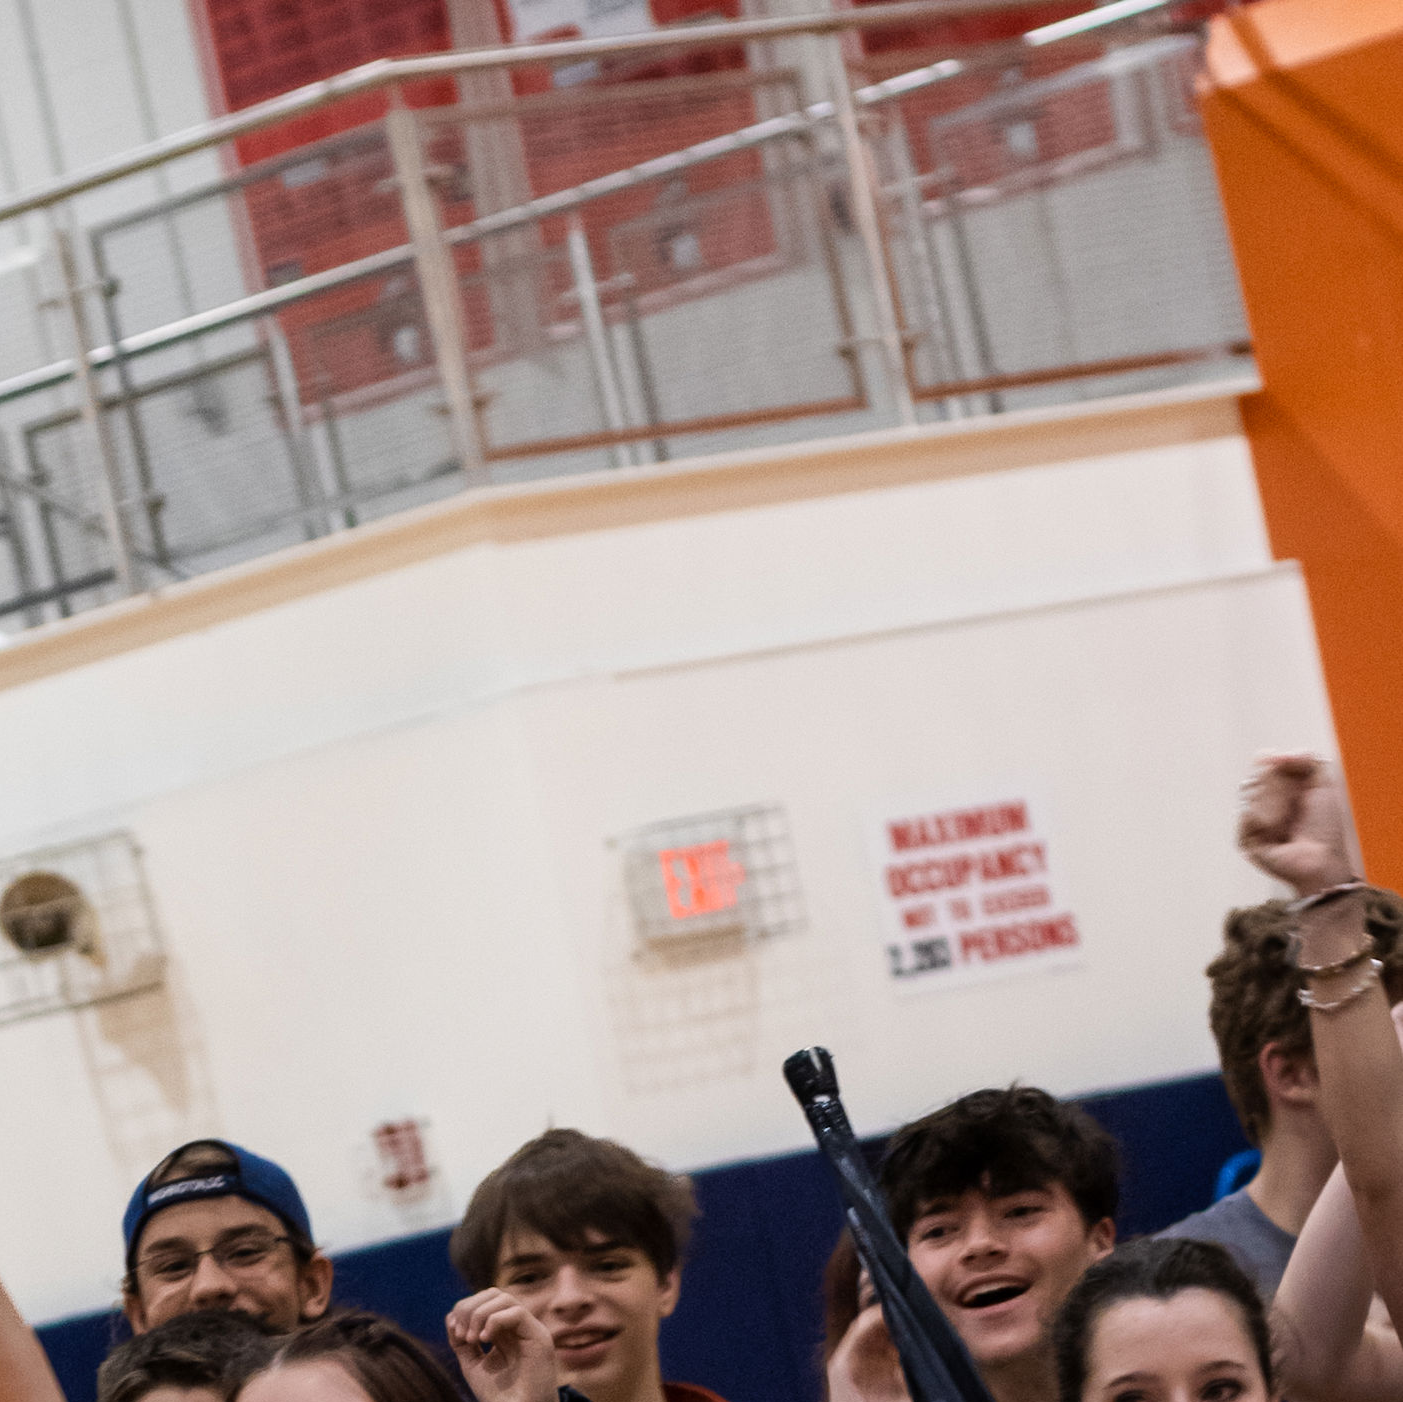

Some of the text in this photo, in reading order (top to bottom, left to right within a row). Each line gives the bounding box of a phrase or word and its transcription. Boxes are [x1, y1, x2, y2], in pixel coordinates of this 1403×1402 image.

[888, 799, 1029, 853] MAXIMUM
[886, 841, 1048, 900] OCCUPANCY
[958, 911, 1079, 964] PERSONS
